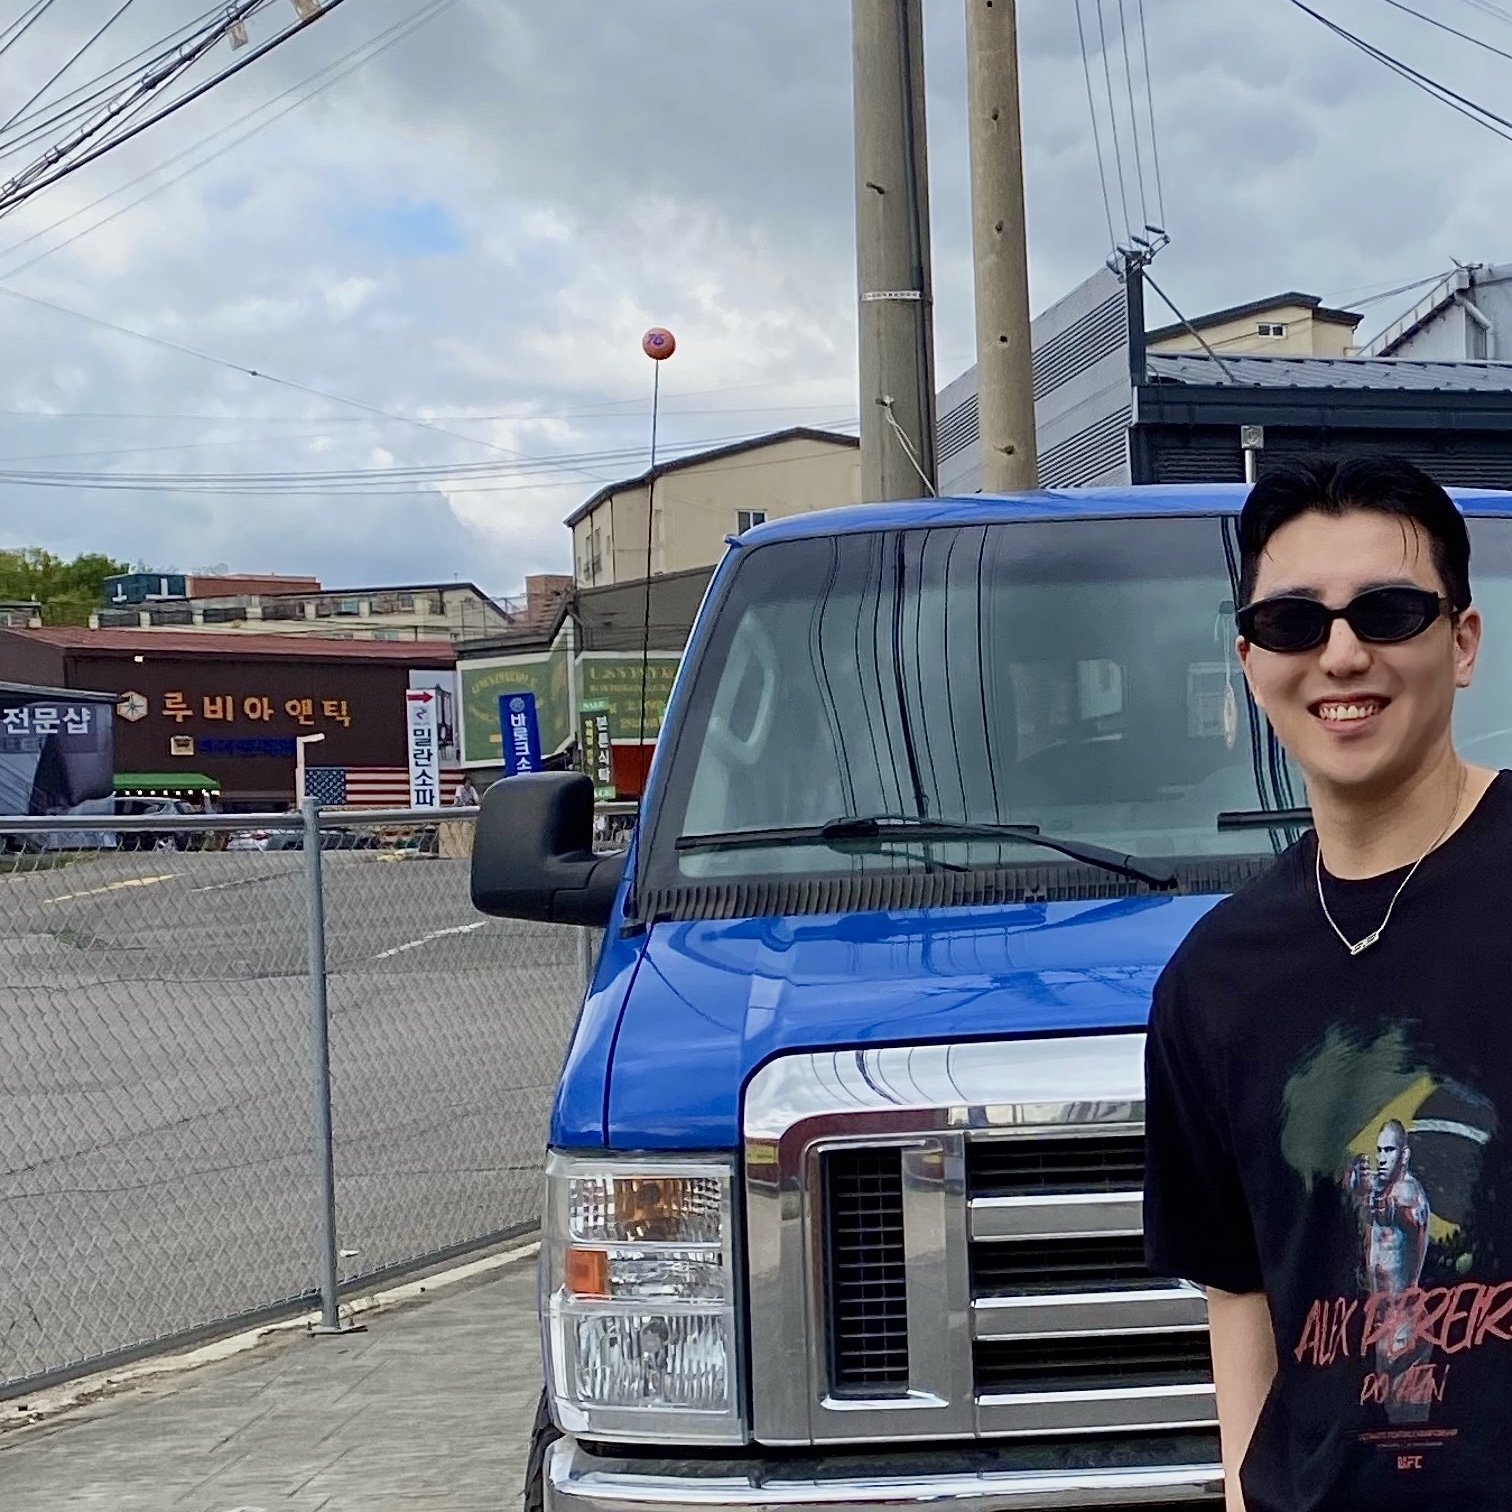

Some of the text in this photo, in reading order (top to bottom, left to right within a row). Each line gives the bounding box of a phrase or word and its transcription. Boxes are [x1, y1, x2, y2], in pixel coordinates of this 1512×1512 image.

[161, 690, 352, 728] 루비아앤틱
[411, 728, 436, 807] 밀란소파
[509, 712, 533, 776] 바로크소
